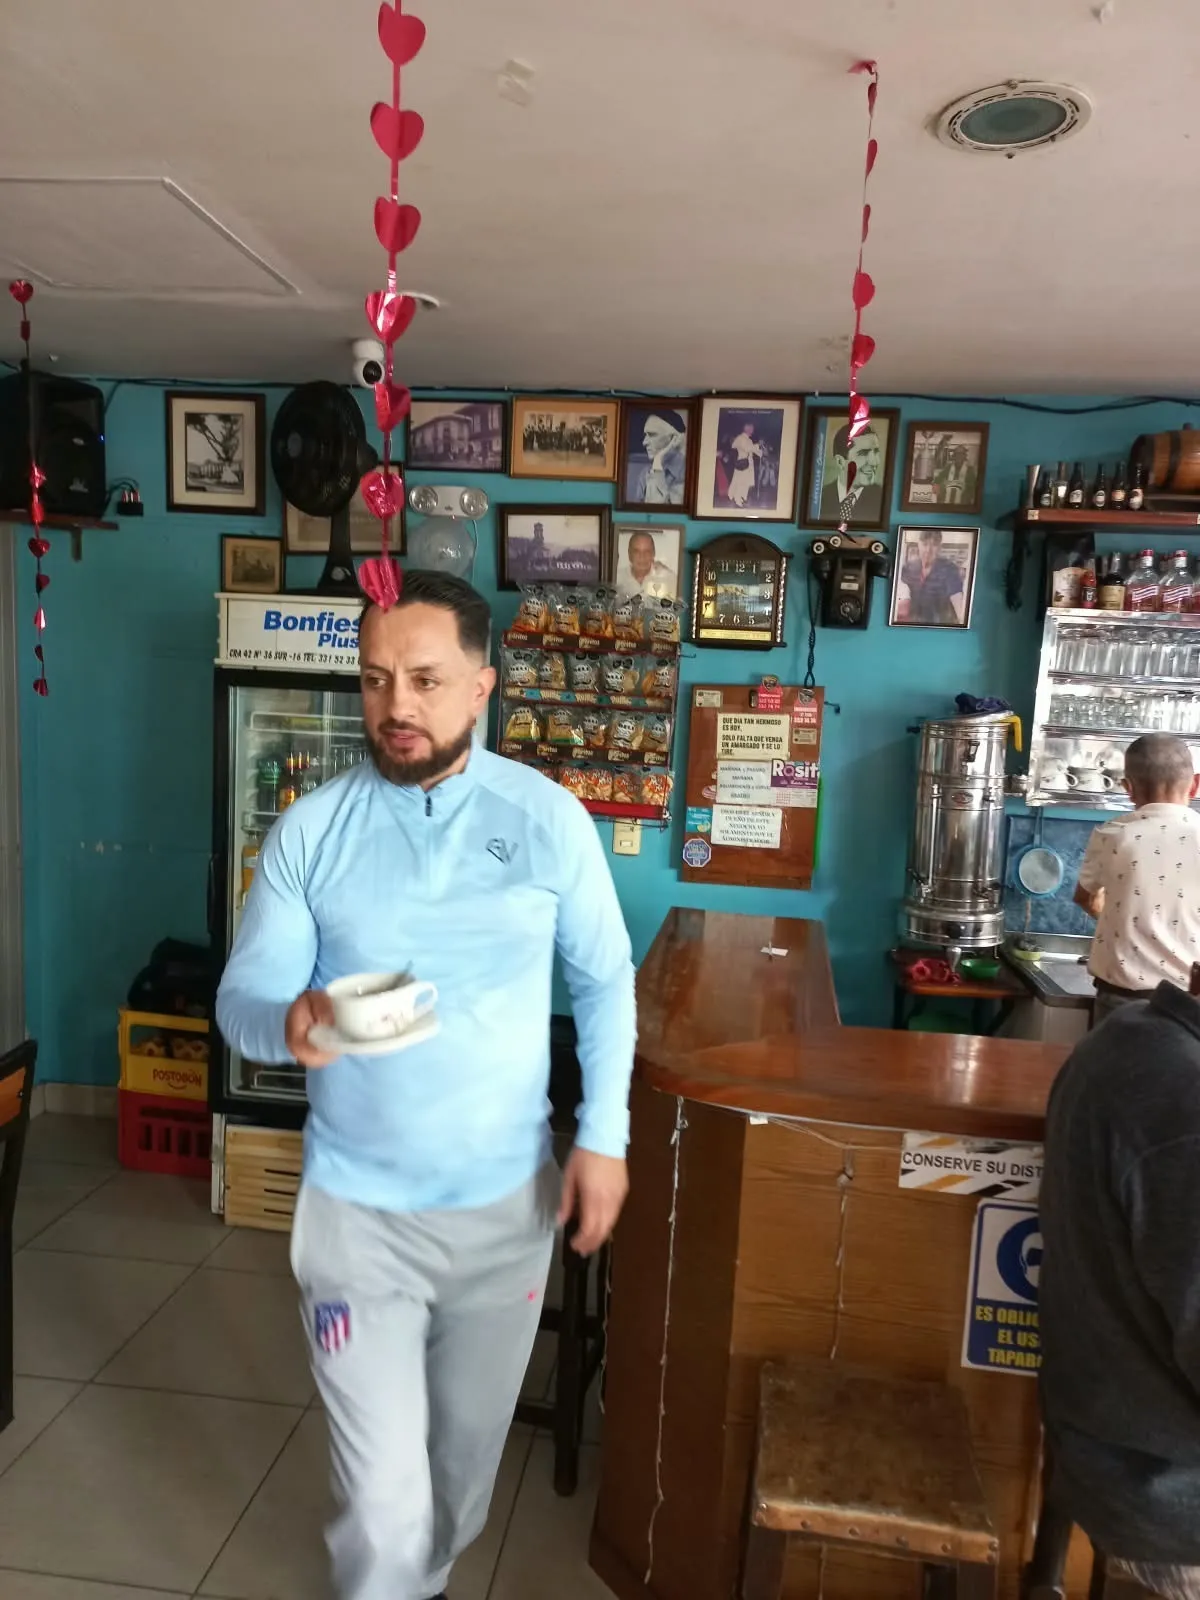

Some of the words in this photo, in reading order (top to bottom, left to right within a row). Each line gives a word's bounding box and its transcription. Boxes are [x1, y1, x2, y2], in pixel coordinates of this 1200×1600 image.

[318, 633, 359, 648] Plus
[755, 718, 782, 726] HERMOSO
[753, 735, 764, 743] QUE
[771, 758, 819, 778] Rosit
[902, 1152, 983, 1172] CONSERVE
[986, 1161, 1005, 1175] SU
[1010, 1164, 1044, 1178] DIST
[976, 1305, 993, 1322] ES
[998, 1329, 1014, 1345] EL
